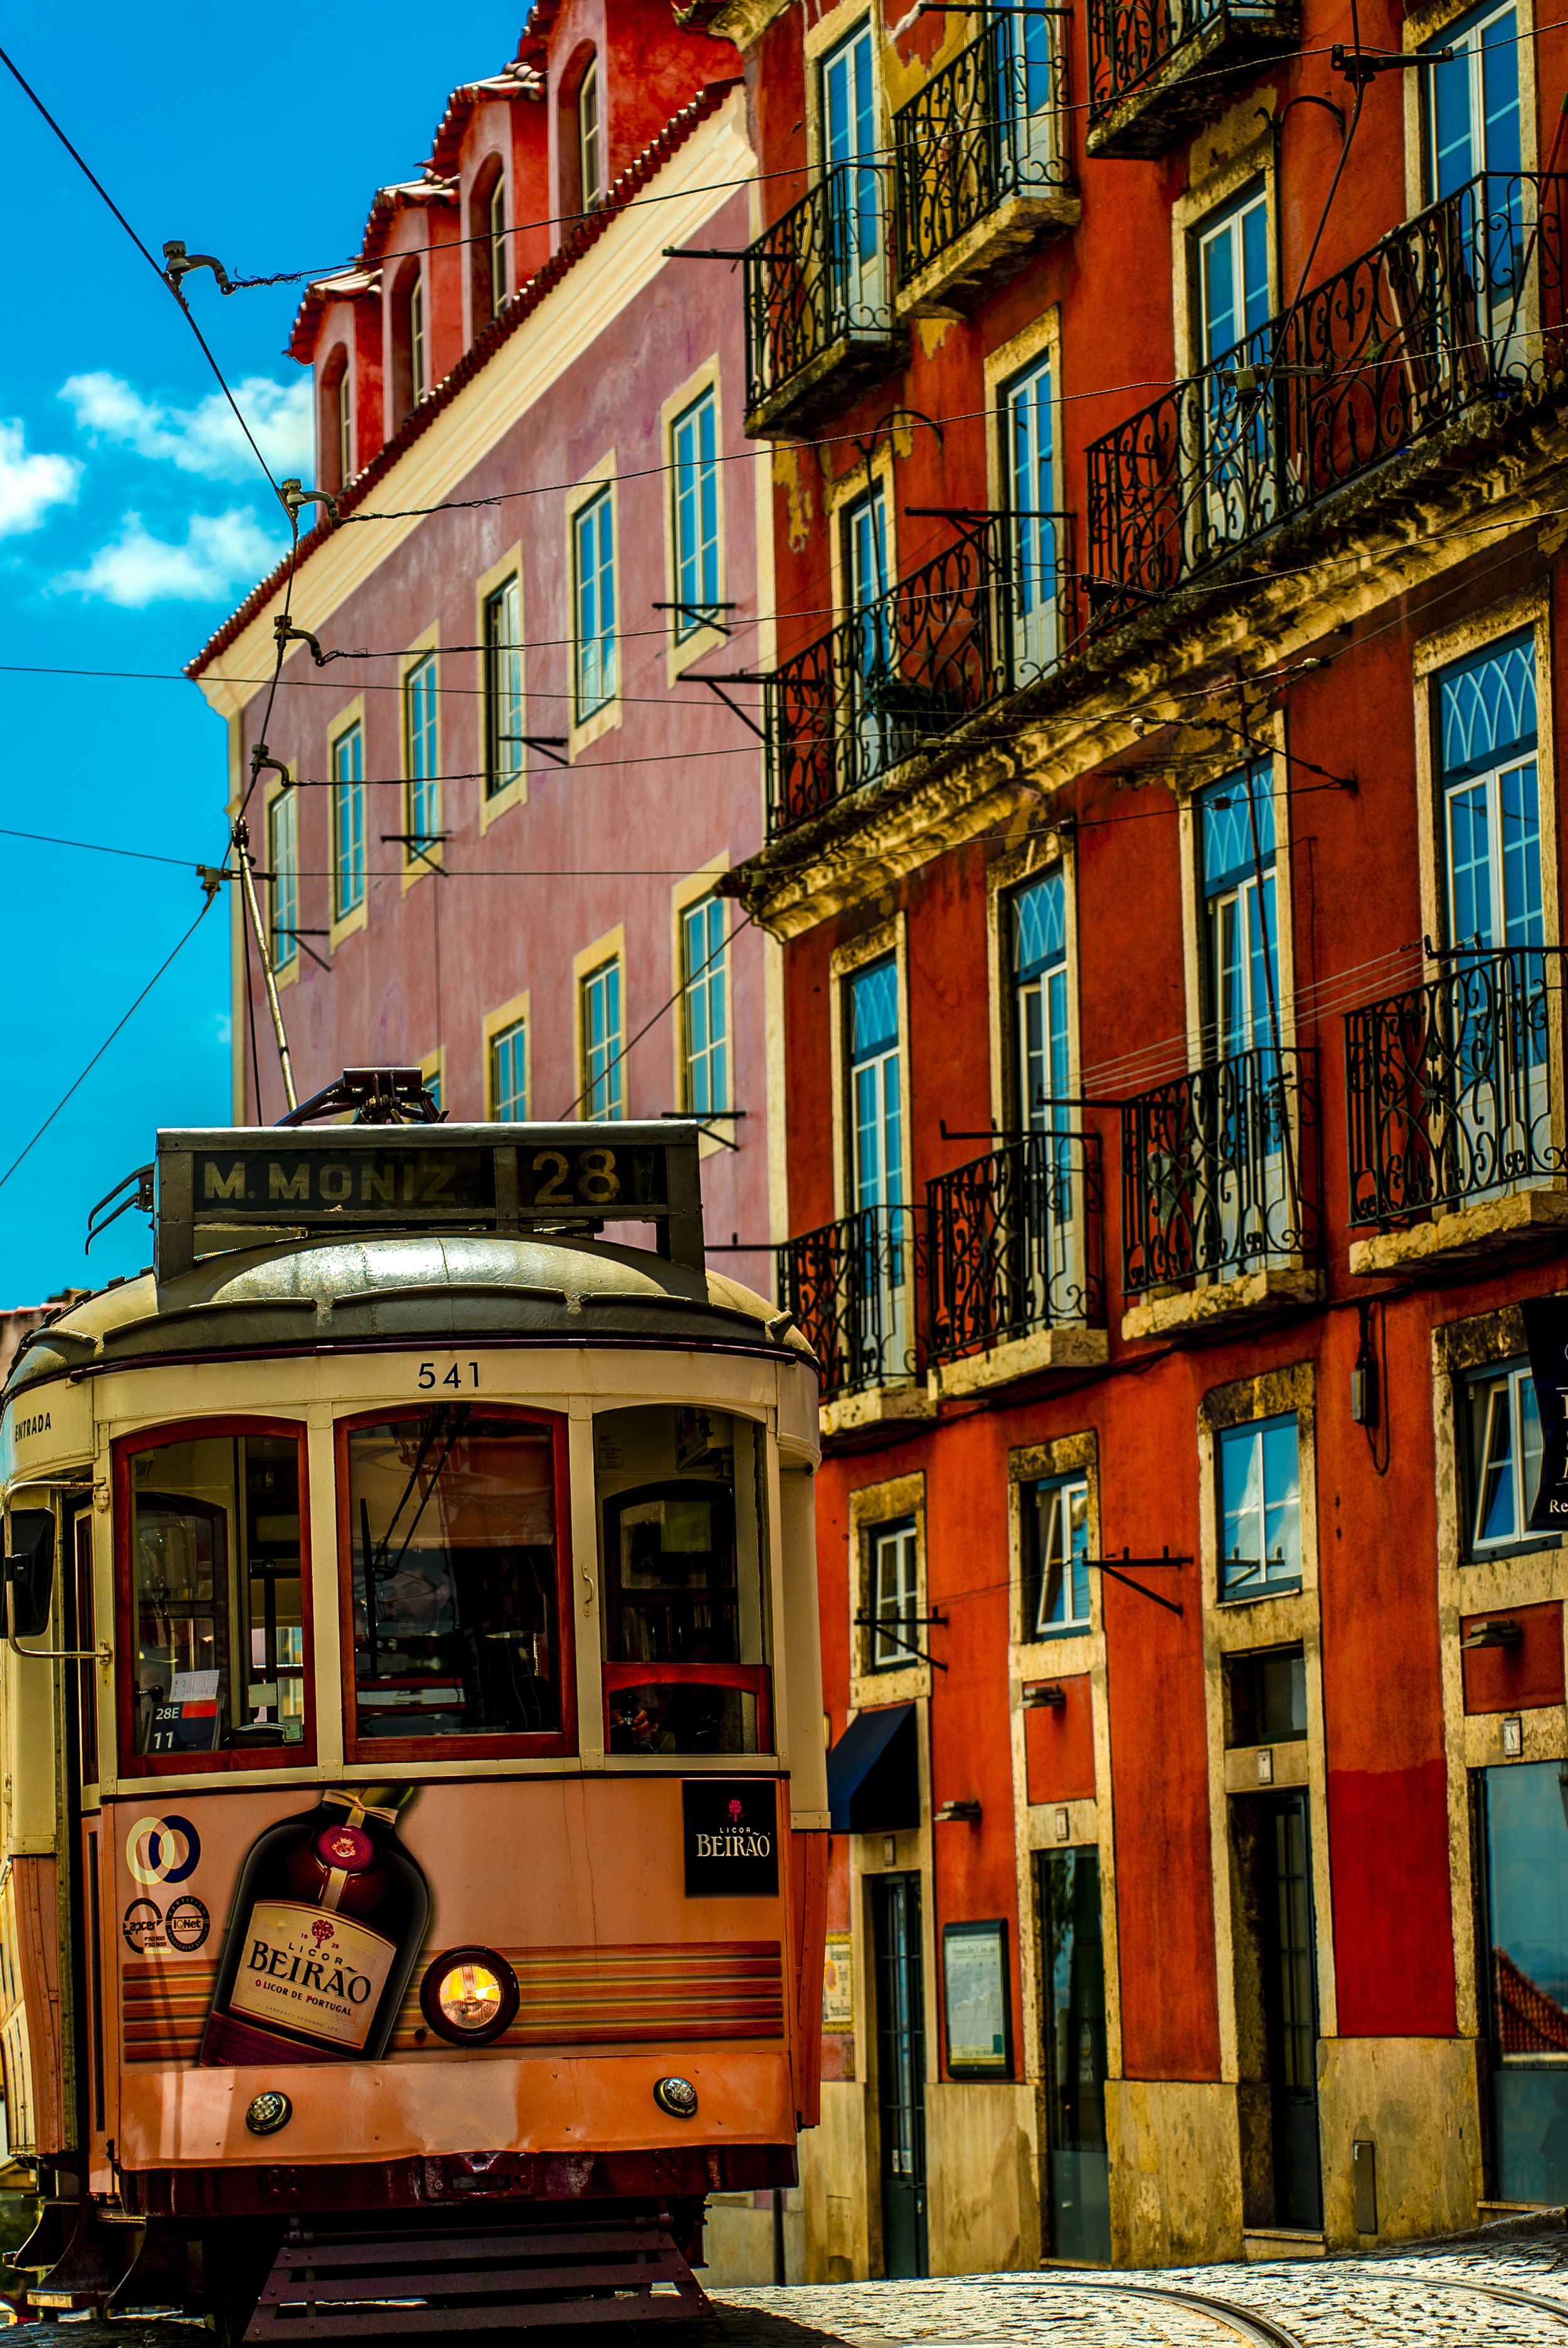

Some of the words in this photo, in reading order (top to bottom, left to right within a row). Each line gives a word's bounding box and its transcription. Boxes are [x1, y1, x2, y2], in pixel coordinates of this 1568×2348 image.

[204, 1162, 255, 1199] M.
[269, 1163, 456, 1201] MONIZ
[532, 1147, 620, 1204] 28
[418, 1362, 479, 1389] 541
[15, 1412, 51, 1443] ENTRADA
[156, 1708, 179, 1719] 28E
[154, 1731, 173, 1749] 11
[696, 1832, 770, 1857] BEIRÃO
[169, 1898, 206, 1916] CERTIFIED
[130, 1921, 156, 1935] apcer
[174, 1919, 201, 1930] IQNet
[289, 1942, 343, 1965] LICOR
[246, 1939, 371, 2005] BEIRÃO
[255, 1979, 262, 1987] O
[263, 1981, 289, 1995] LICOR
[291, 1990, 304, 2000] DE
[305, 1995, 352, 2016] PORTUGAL
